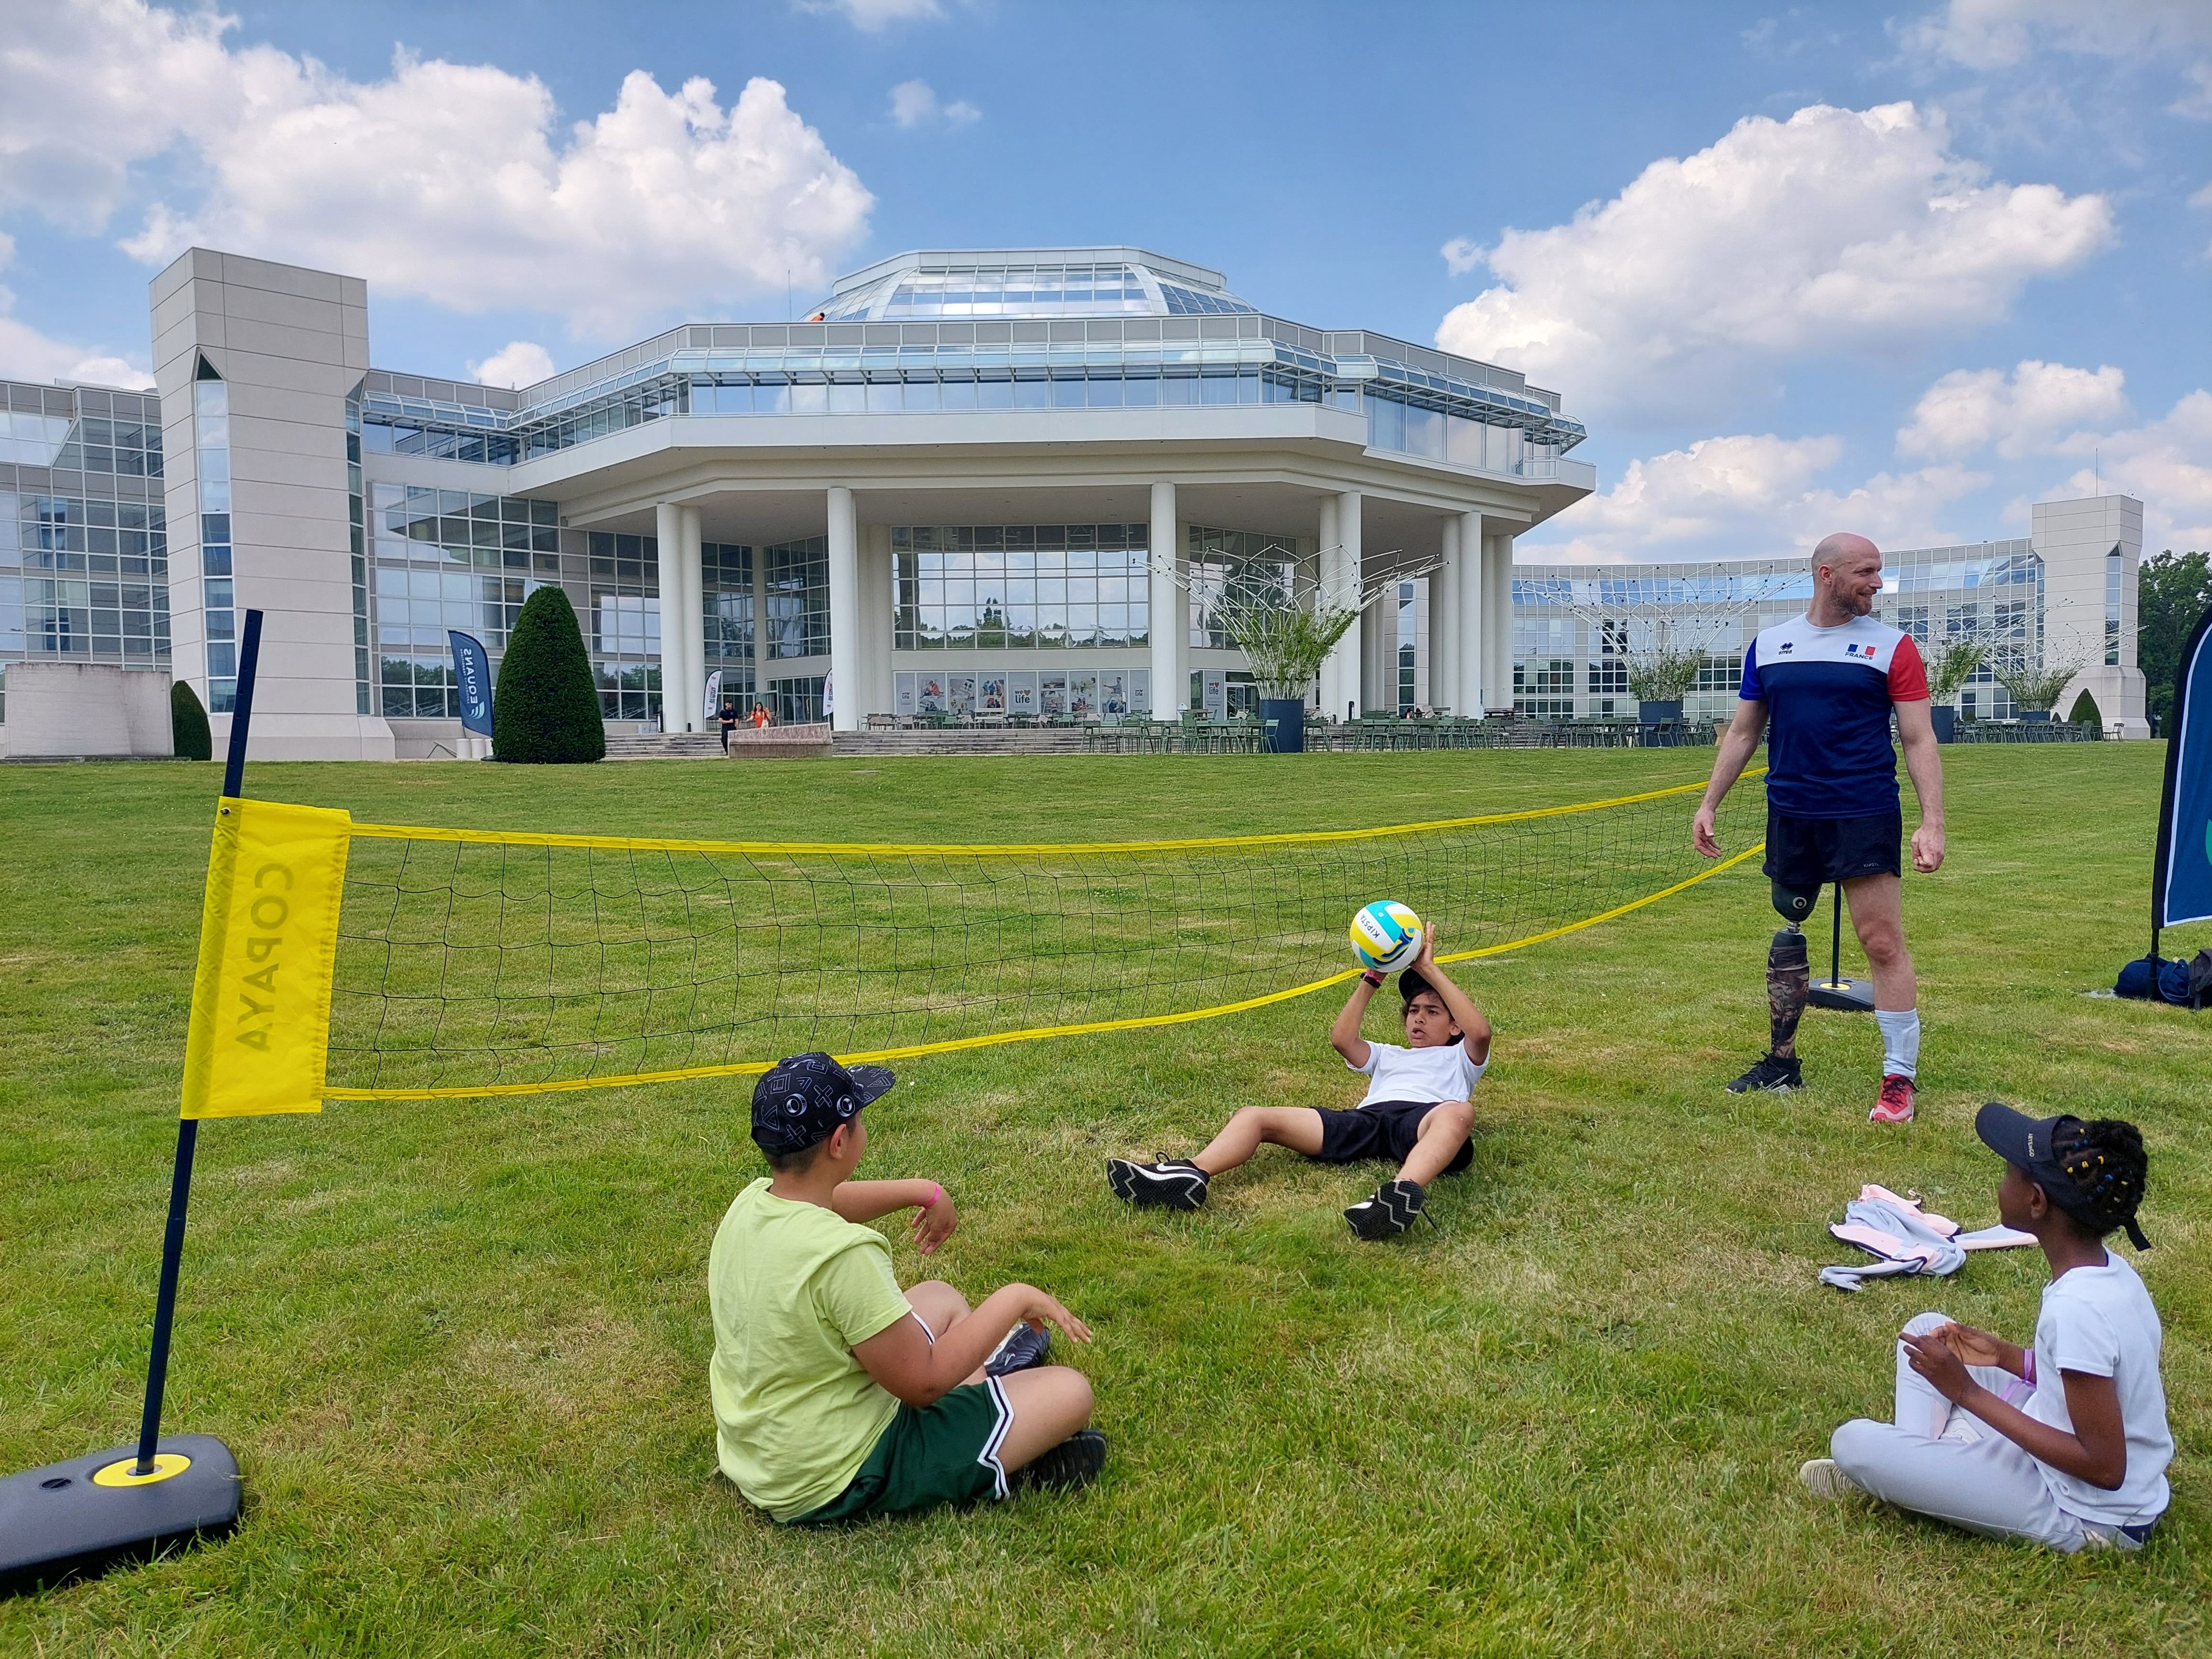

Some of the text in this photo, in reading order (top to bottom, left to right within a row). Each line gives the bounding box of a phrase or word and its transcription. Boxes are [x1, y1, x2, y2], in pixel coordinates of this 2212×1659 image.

[1845, 652, 1874, 660] FRANCE
[1209, 686, 1219, 695] life
[1015, 695, 1030, 703] life
[1360, 914, 1380, 938] KIPSTA
